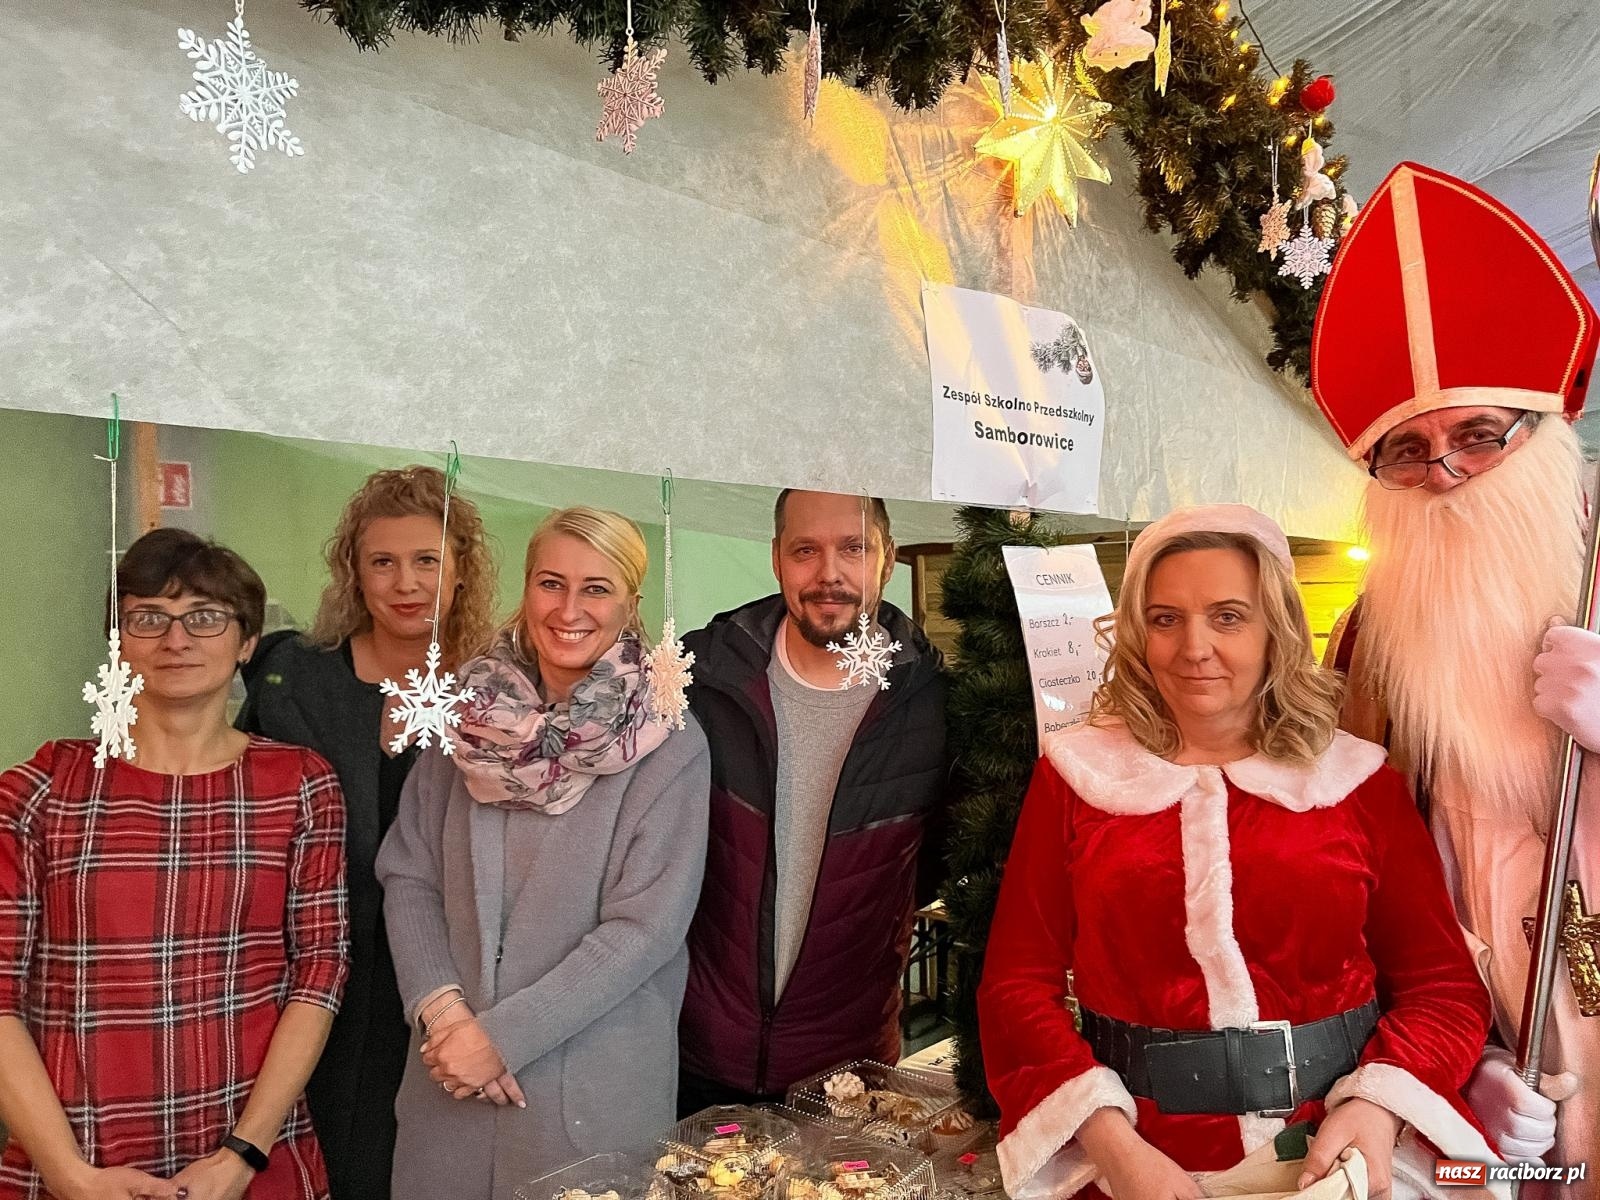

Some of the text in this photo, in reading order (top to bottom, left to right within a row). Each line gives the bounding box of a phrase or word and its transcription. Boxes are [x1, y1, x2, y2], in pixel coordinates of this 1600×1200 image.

[942, 385, 1095, 426] Zespół Szkolno Przedszkolny
[974, 420, 1075, 451] Samborowice
[1036, 573, 1076, 586] CENNIK
[1029, 618, 1061, 629] Barszcz
[1033, 647, 1062, 659] Krokiet
[1038, 674, 1081, 689] Ciasteczko
